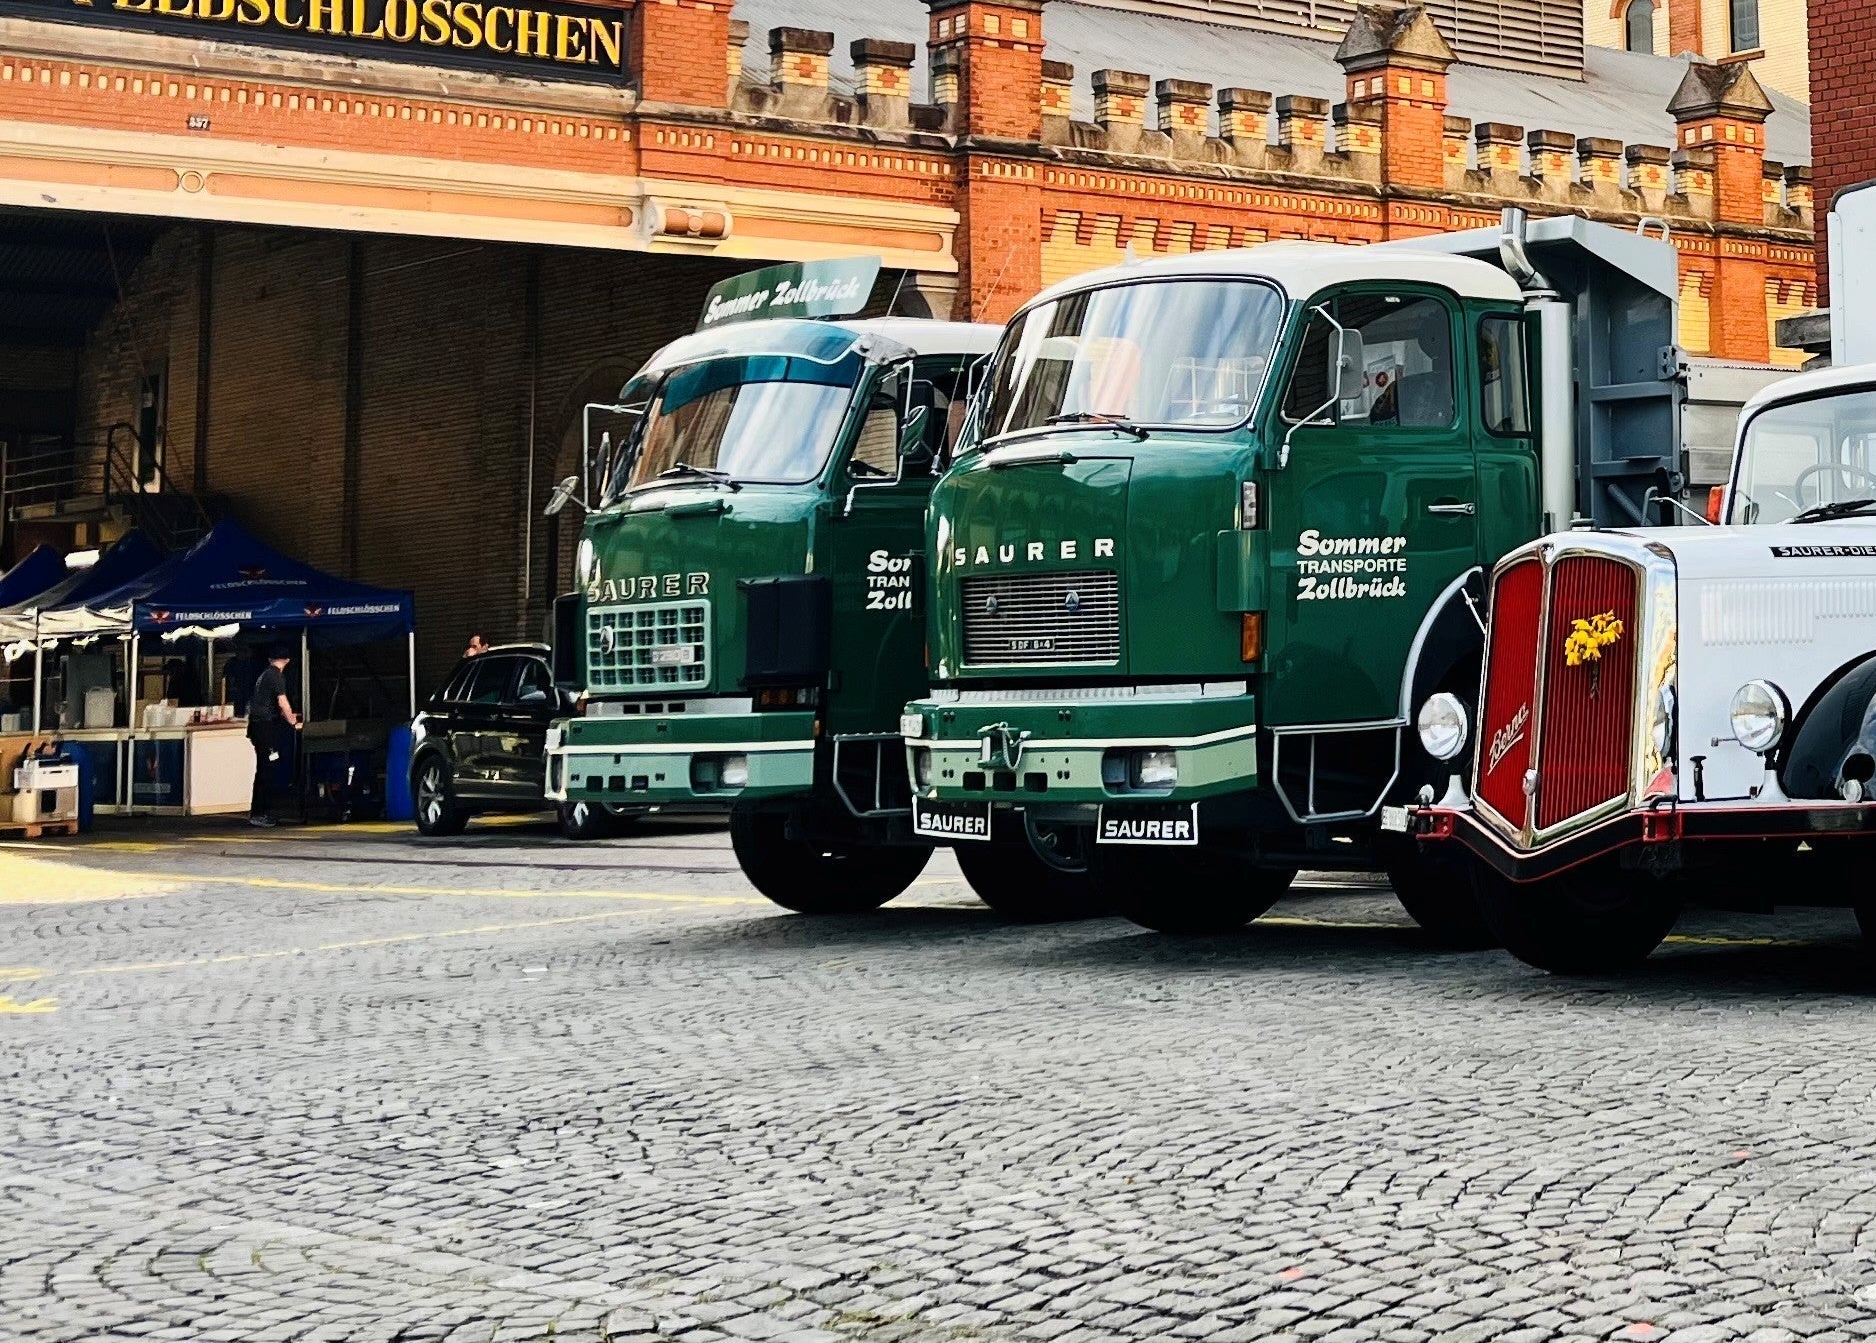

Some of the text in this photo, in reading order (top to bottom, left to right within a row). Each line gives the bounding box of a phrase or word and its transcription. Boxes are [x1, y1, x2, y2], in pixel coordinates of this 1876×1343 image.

[703, 289, 770, 324] Sommer
[954, 538, 1114, 566] SAURER
[1296, 529, 1407, 556] Sommer
[1296, 558, 1407, 574] TRANSPORTE
[586, 572, 710, 603] SAURER
[866, 575, 910, 588] TRAN
[1296, 575, 1407, 601] Zollbrück
[865, 590, 912, 610] Zoll
[919, 812, 986, 834] SAURER
[1104, 819, 1190, 839] SAURER
